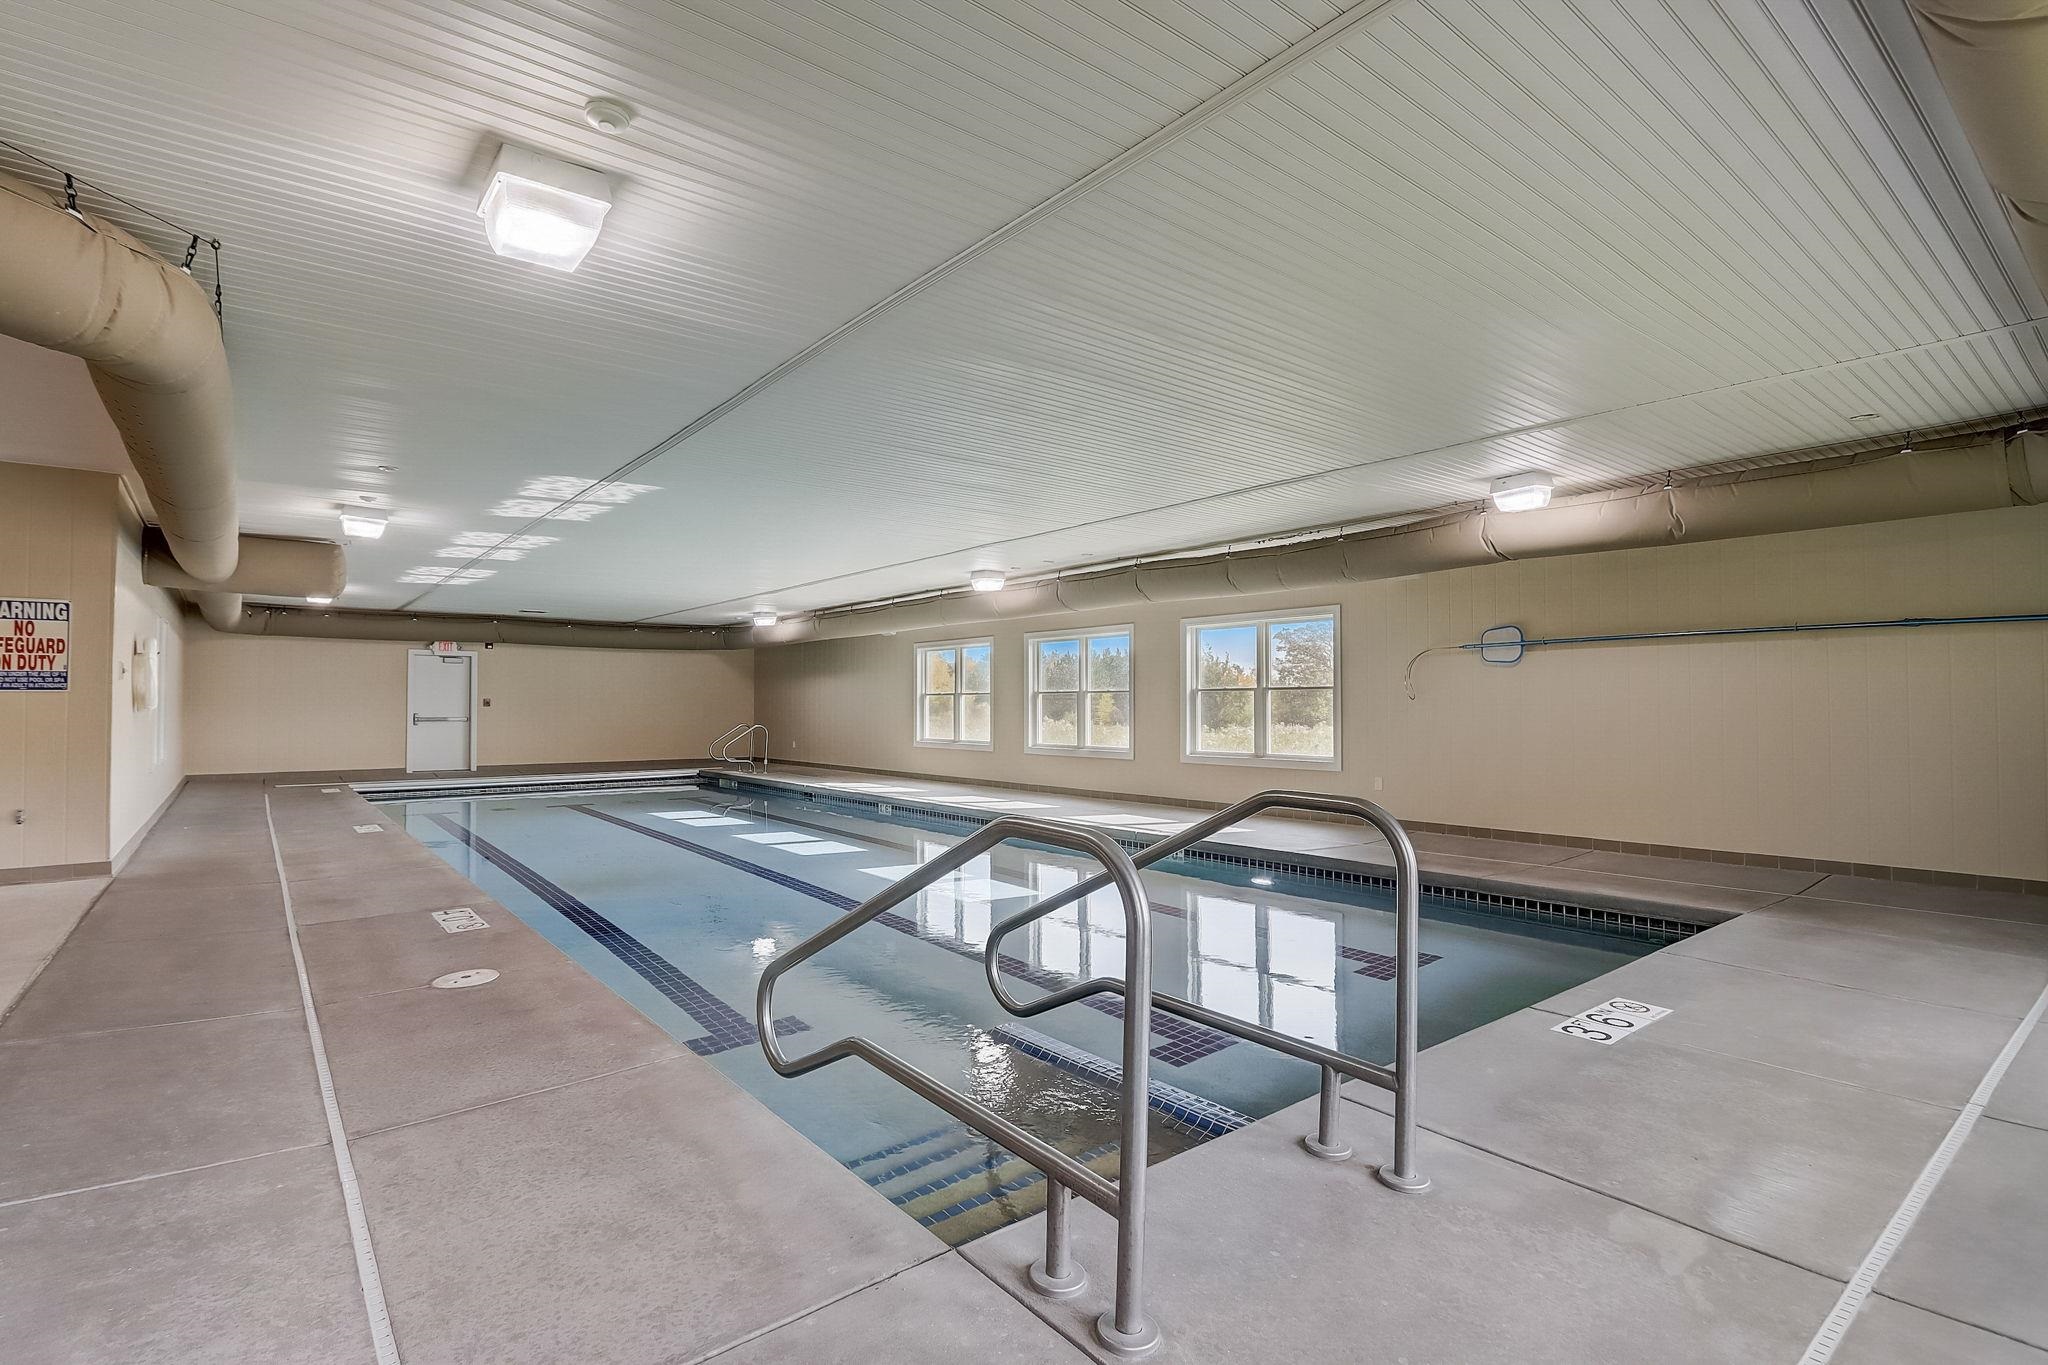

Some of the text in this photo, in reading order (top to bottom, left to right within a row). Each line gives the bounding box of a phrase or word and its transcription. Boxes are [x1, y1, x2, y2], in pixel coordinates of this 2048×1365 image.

[14, 620, 35, 636] NO
[438, 640, 452, 650] EXIT
[0, 654, 56, 671] N DUTY
[1585, 1013, 1635, 1028] 6
[1561, 1025, 1613, 1041] 3
